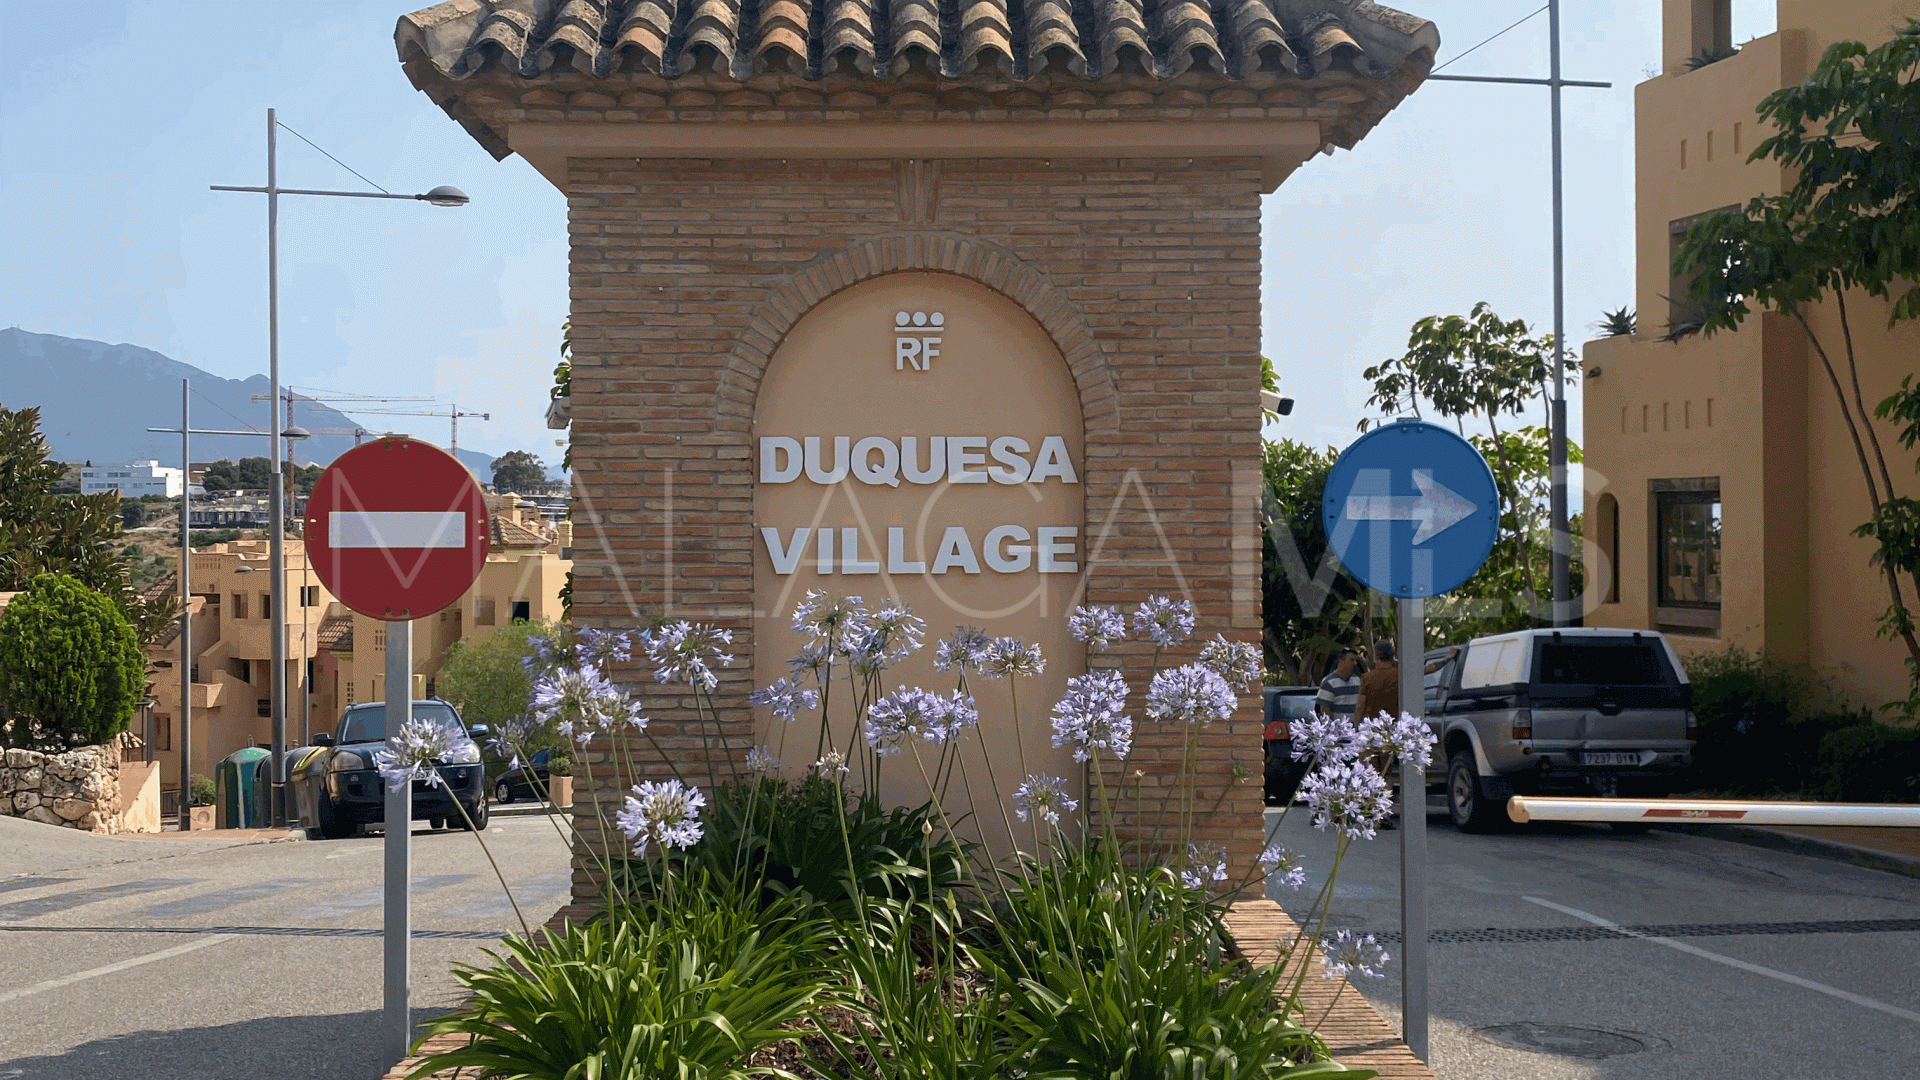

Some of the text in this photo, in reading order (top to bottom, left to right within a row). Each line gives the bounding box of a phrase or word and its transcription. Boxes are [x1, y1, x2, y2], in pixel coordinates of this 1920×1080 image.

[896, 337, 942, 371] RF
[759, 436, 1078, 488] DUQUESA
[760, 525, 1078, 575] VILLAGE
